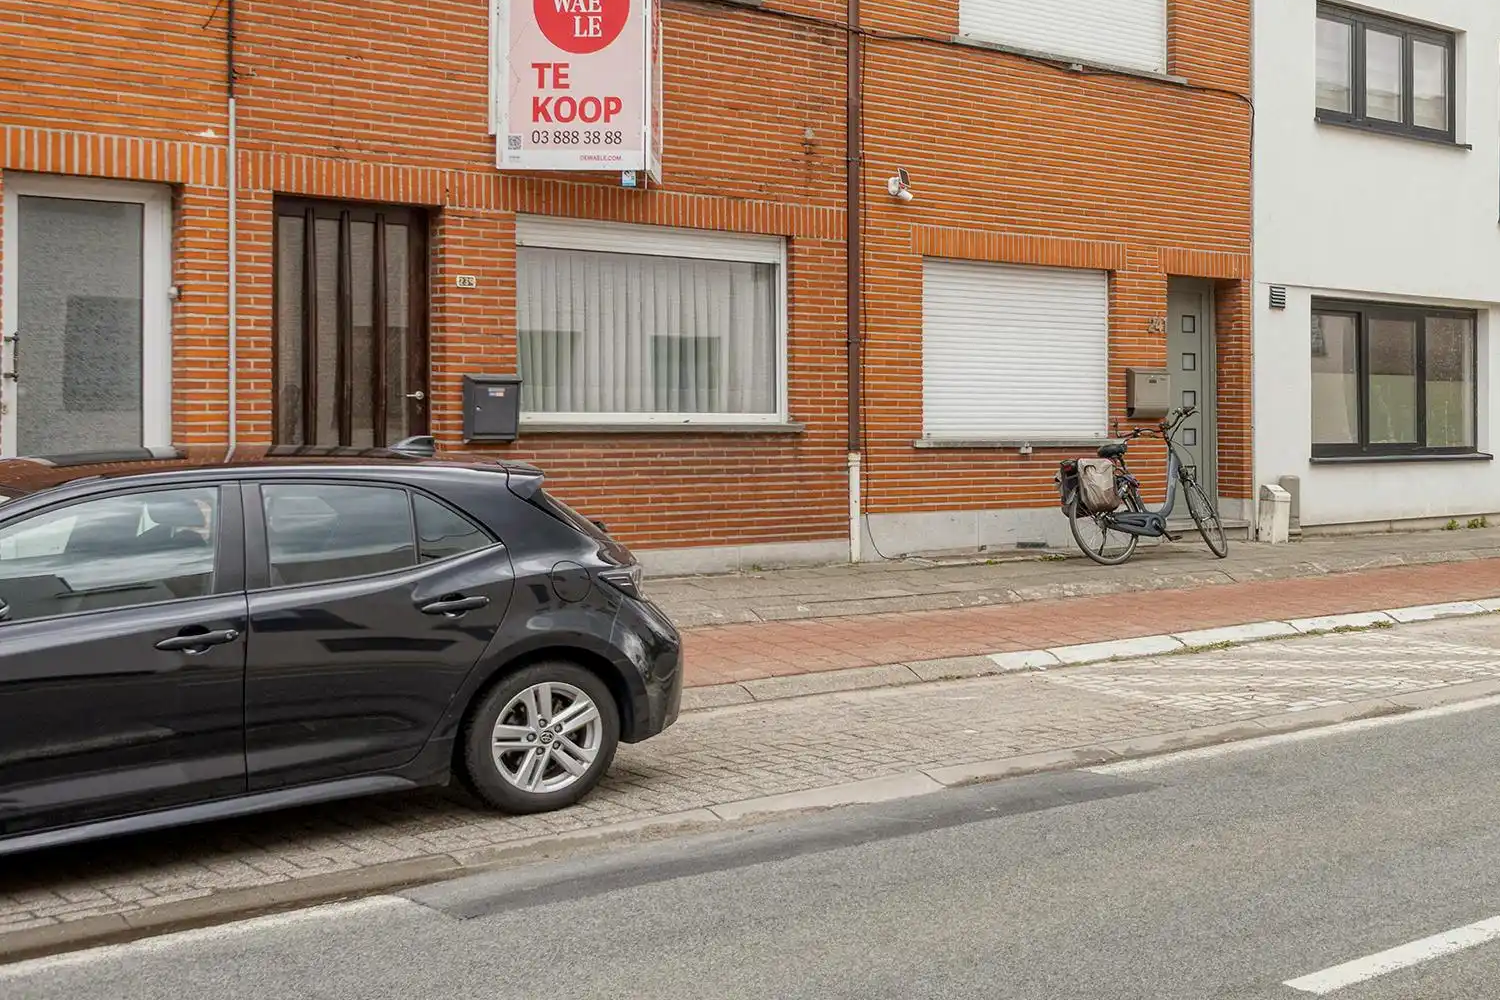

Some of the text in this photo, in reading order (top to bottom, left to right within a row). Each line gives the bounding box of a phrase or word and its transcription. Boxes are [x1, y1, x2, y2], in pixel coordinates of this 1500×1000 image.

[573, 16, 603, 38] LE
[531, 63, 570, 89] TE
[531, 96, 623, 124] KOOP
[531, 130, 623, 145] 03 888 38 88
